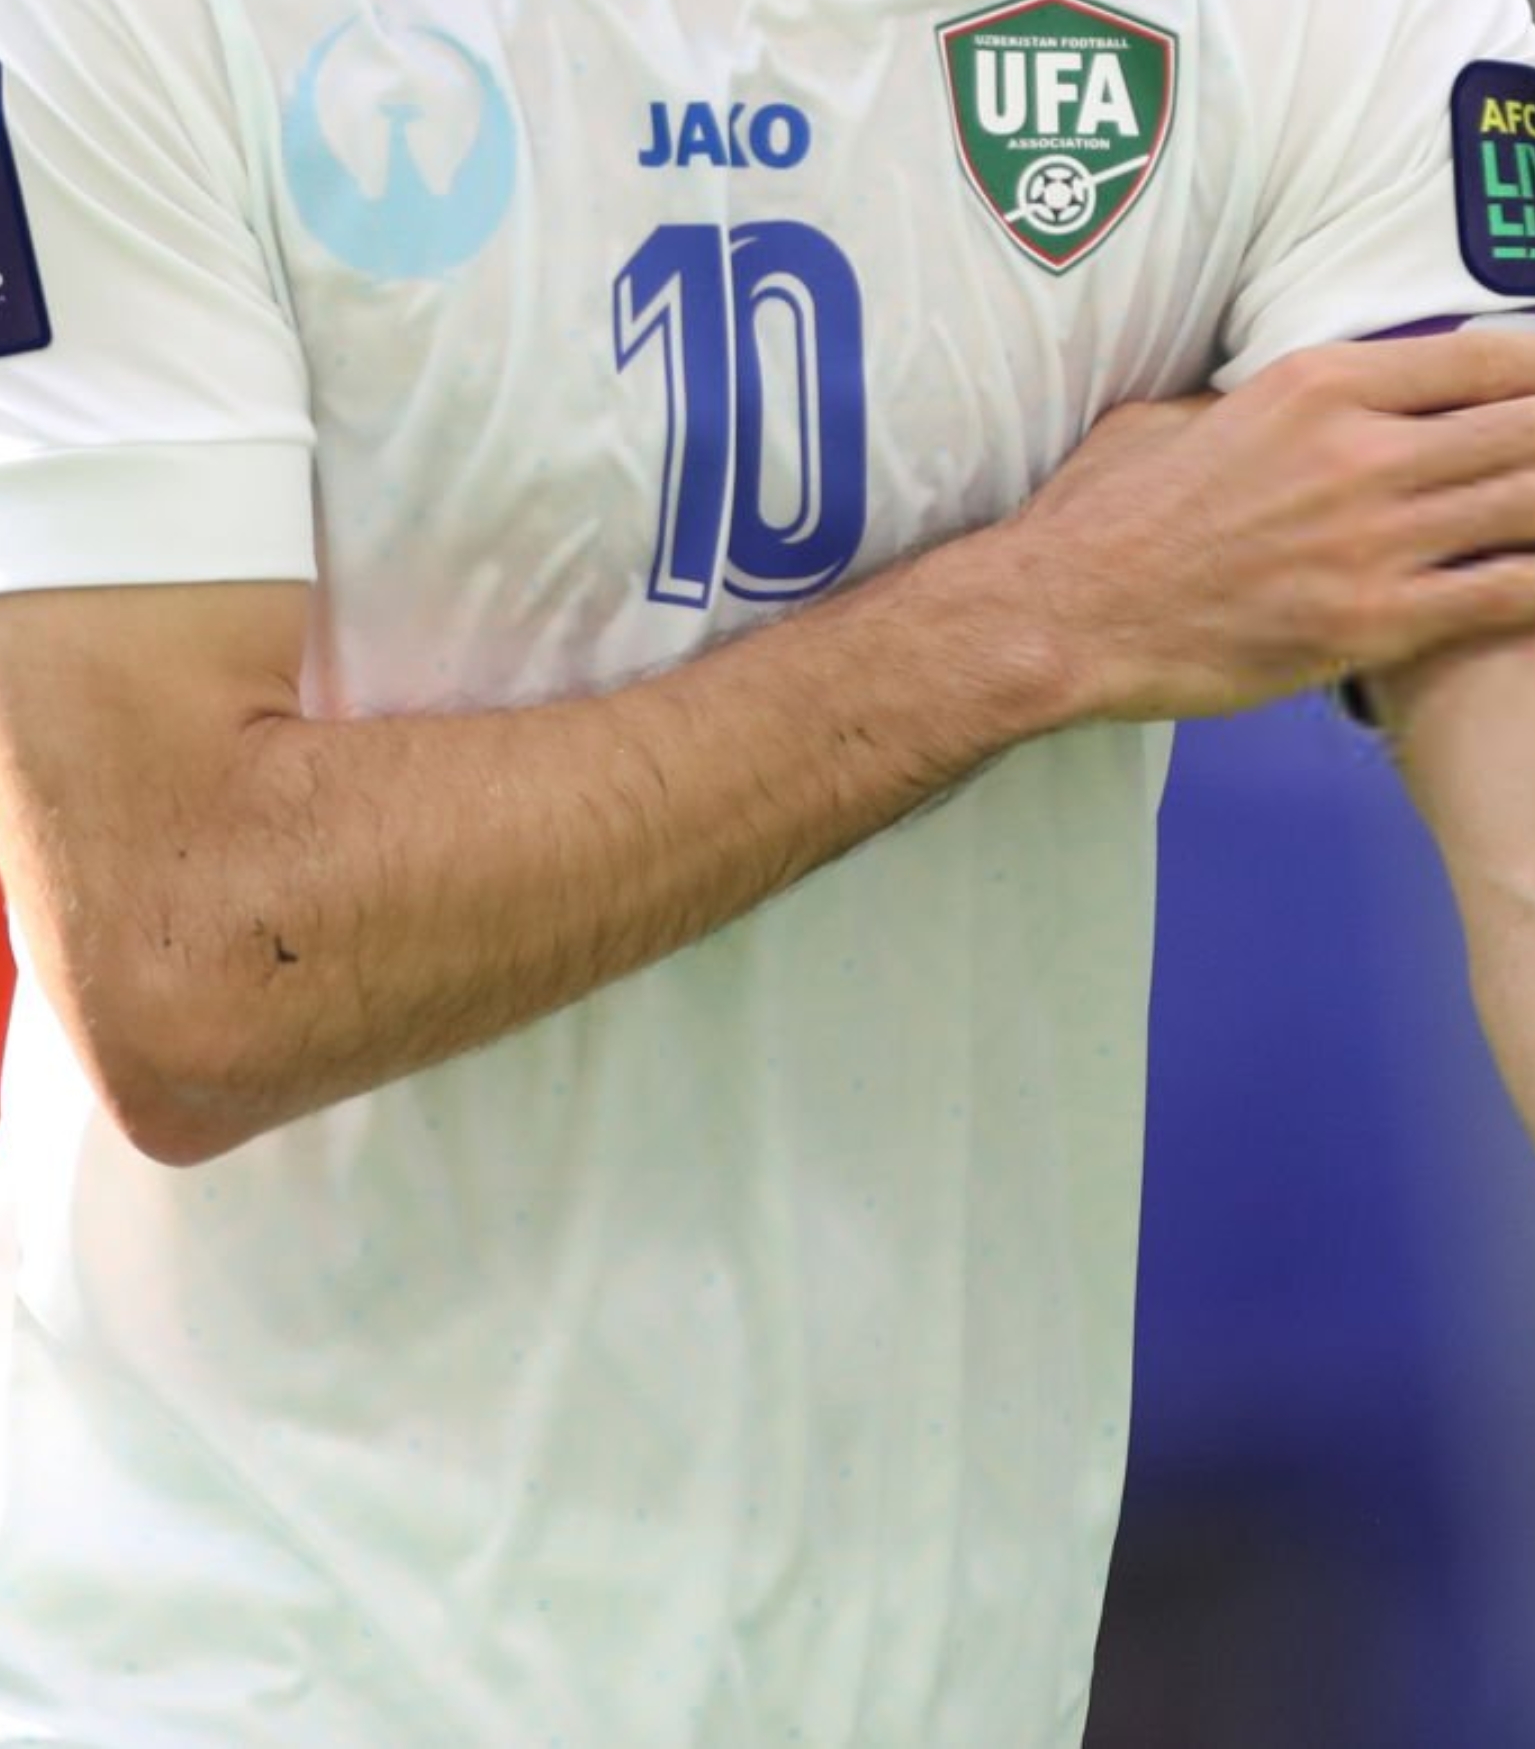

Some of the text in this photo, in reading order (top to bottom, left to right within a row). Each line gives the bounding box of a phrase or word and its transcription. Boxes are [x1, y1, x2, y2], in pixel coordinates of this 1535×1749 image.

[974, 34, 1129, 49] UZBEKISTAN FOOTBALL
[975, 50, 1140, 138] UFA
[638, 101, 812, 170] JAKO
[1007, 136, 1110, 151] ASSOCIATION
[612, 218, 867, 610] 10
